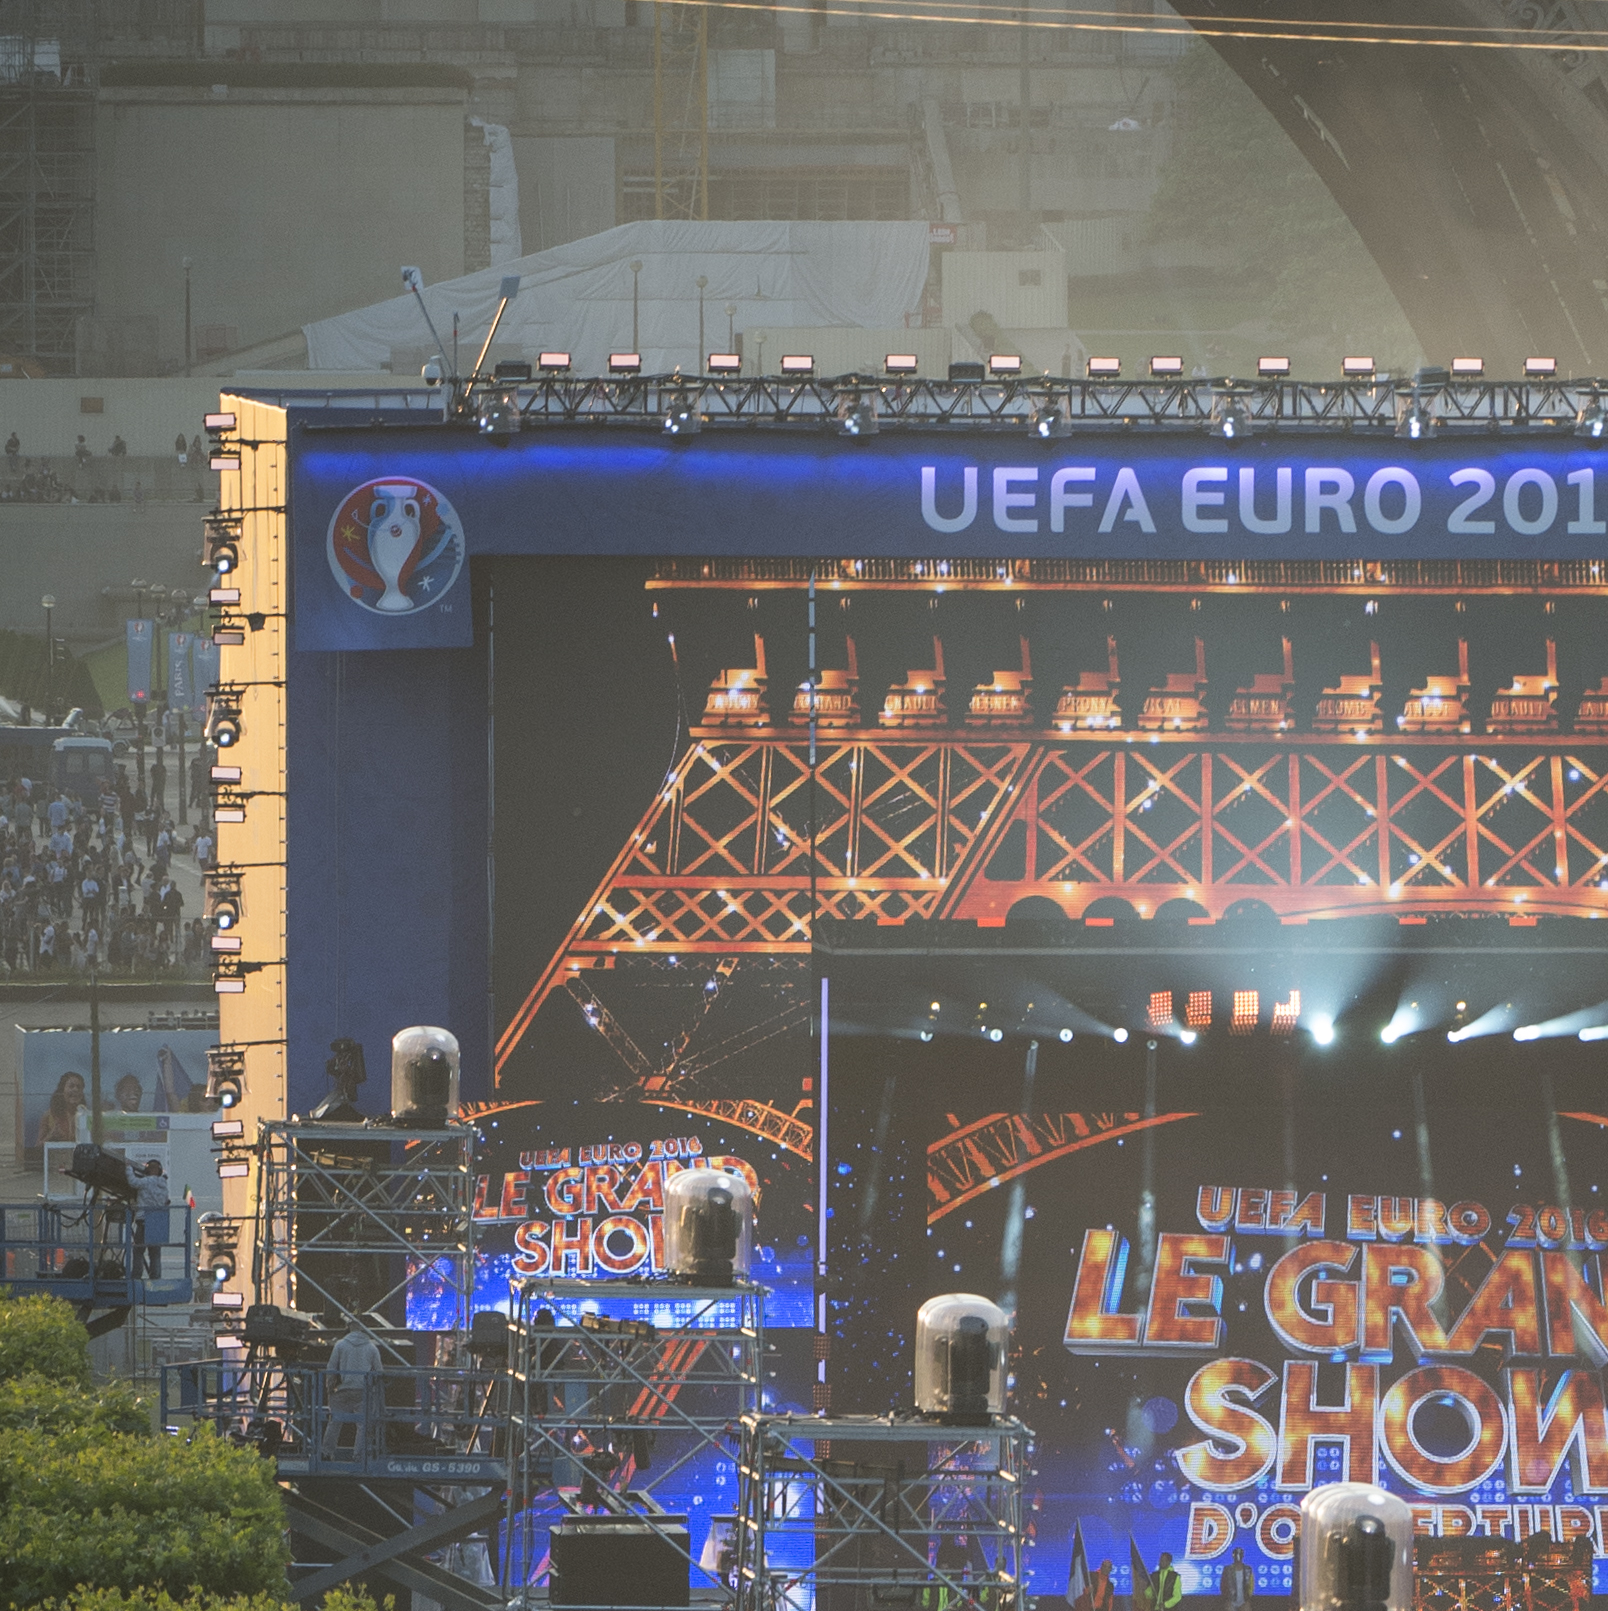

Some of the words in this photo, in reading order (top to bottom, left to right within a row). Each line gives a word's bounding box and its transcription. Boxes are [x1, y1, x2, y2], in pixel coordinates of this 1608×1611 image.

[920, 466, 1157, 534] UEFA
[1180, 466, 1422, 535] EURO
[519, 1146, 572, 1171] UEFA
[579, 1141, 642, 1166] EURO
[650, 1136, 703, 1159] 2016
[472, 1171, 532, 1222] LE
[1197, 1185, 1326, 1237] UEFA
[1346, 1194, 1492, 1245] EURO
[511, 1214, 666, 1275] SHO
[1063, 1228, 1233, 1356] LE
